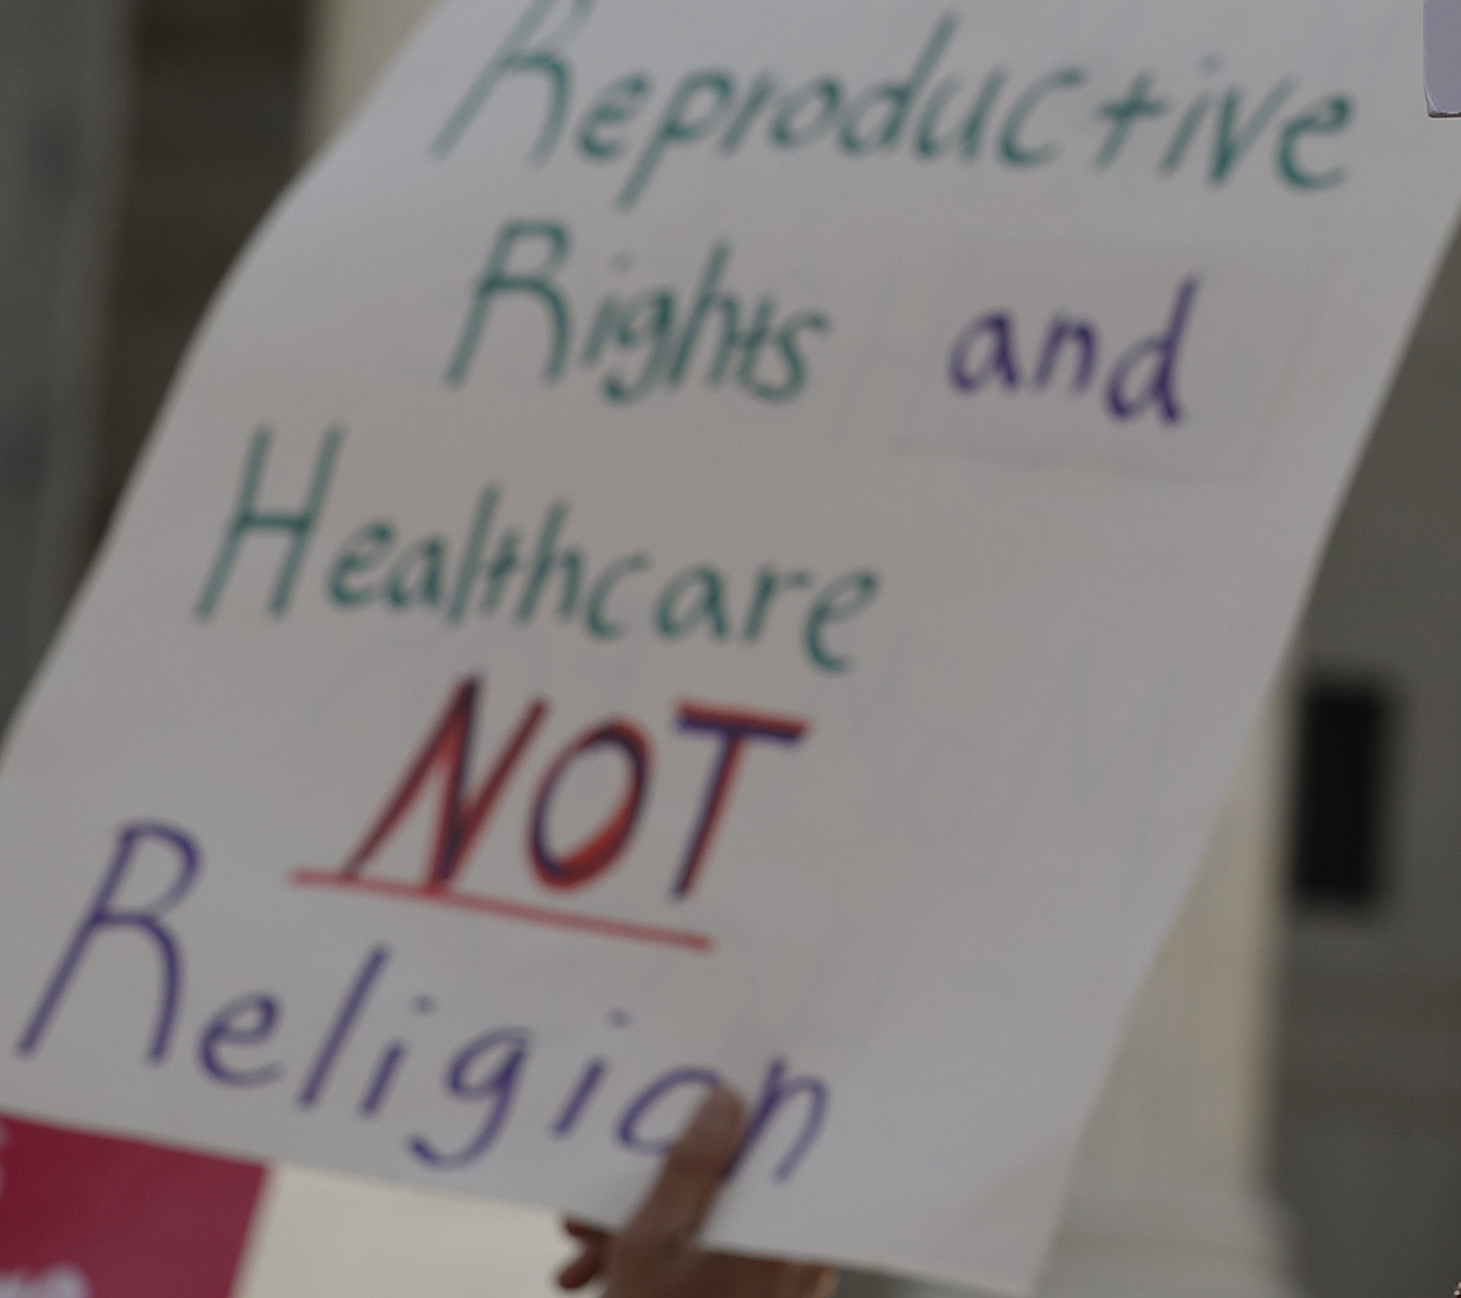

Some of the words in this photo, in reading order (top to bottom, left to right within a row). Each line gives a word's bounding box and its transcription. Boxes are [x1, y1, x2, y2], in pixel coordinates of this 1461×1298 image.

[443, 218, 832, 404] Rights
[946, 273, 1202, 429] and
[191, 421, 883, 675] Healthcare
[340, 671, 814, 904] NOT
[16, 821, 832, 1184] Religion
